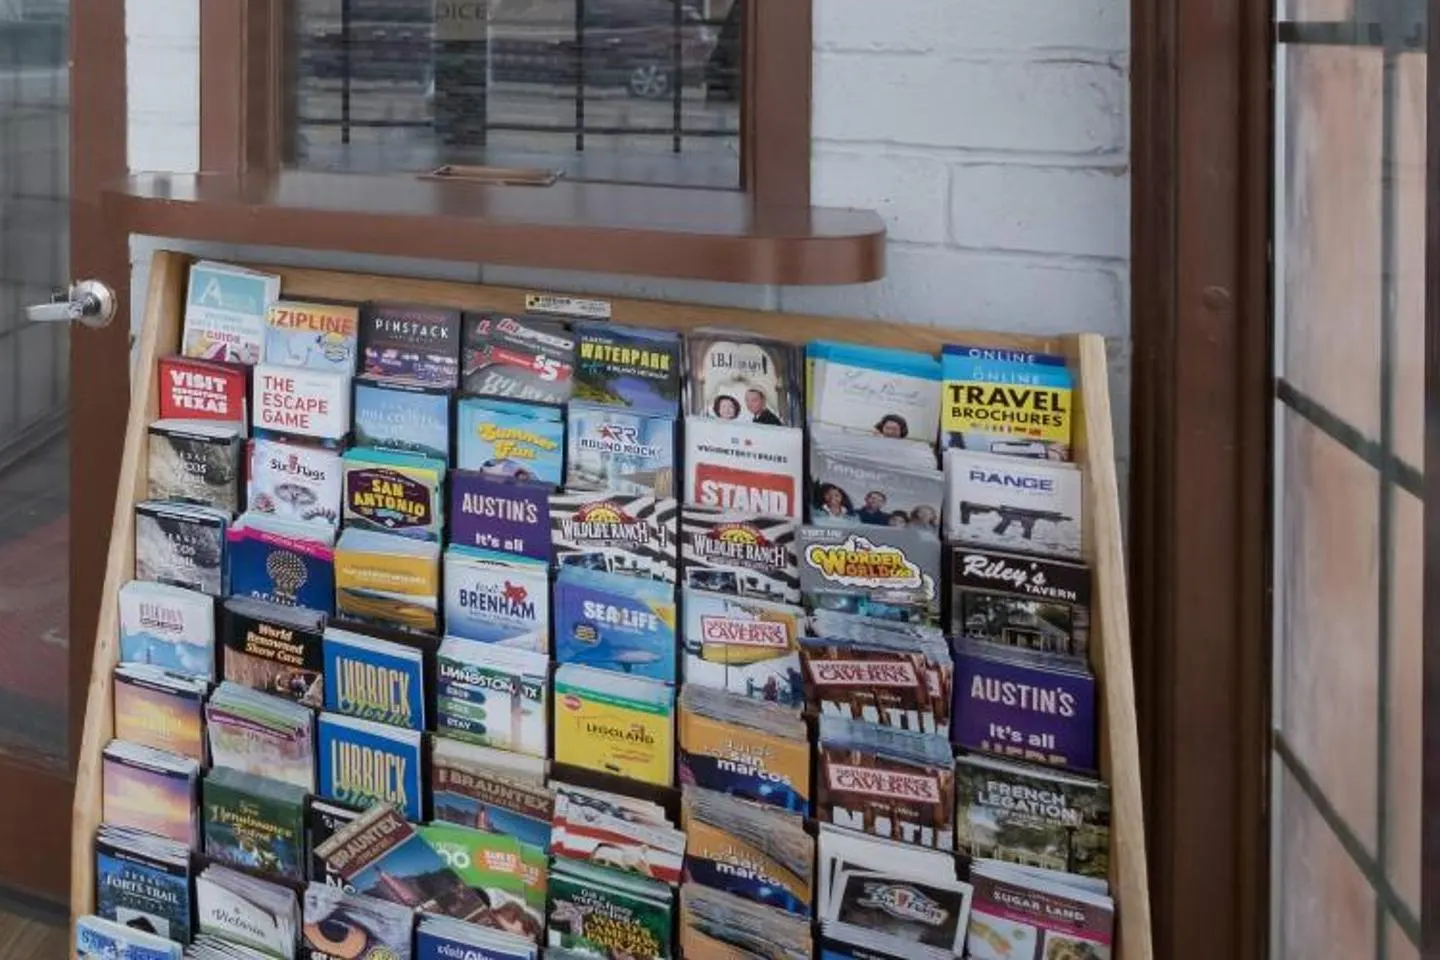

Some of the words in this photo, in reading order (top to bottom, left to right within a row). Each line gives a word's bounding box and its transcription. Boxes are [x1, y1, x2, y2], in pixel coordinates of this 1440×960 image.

[375, 318, 449, 339] PINSTACK
[581, 343, 669, 371] WATERPARK
[969, 348, 1035, 364] ONLINE
[264, 376, 295, 392] THE
[172, 394, 227, 414] TEXAS
[263, 393, 328, 415] ESCAPE
[948, 384, 1065, 414] TRAVEL
[263, 409, 309, 429] GAME
[952, 406, 1062, 428] BROCHURES
[477, 423, 557, 449] Summer
[372, 479, 404, 497] SAN
[969, 469, 1053, 491] RANGE
[354, 492, 425, 517] ANTONIO
[462, 493, 538, 524] AUSTIN'S
[702, 481, 787, 515] STAND
[963, 555, 1048, 587] Riley's
[1024, 583, 1077, 602] TAVERN
[460, 589, 536, 621] BRENHAM
[623, 608, 658, 631] LIFE
[971, 675, 1077, 718] AUSTIN'S
[990, 723, 1023, 743] It's
[1028, 731, 1055, 750] all
[717, 759, 792, 786] marcos
[987, 781, 1065, 805] FRENCH
[978, 791, 1077, 827] LEGATION
[993, 890, 1040, 912] SUGAR
